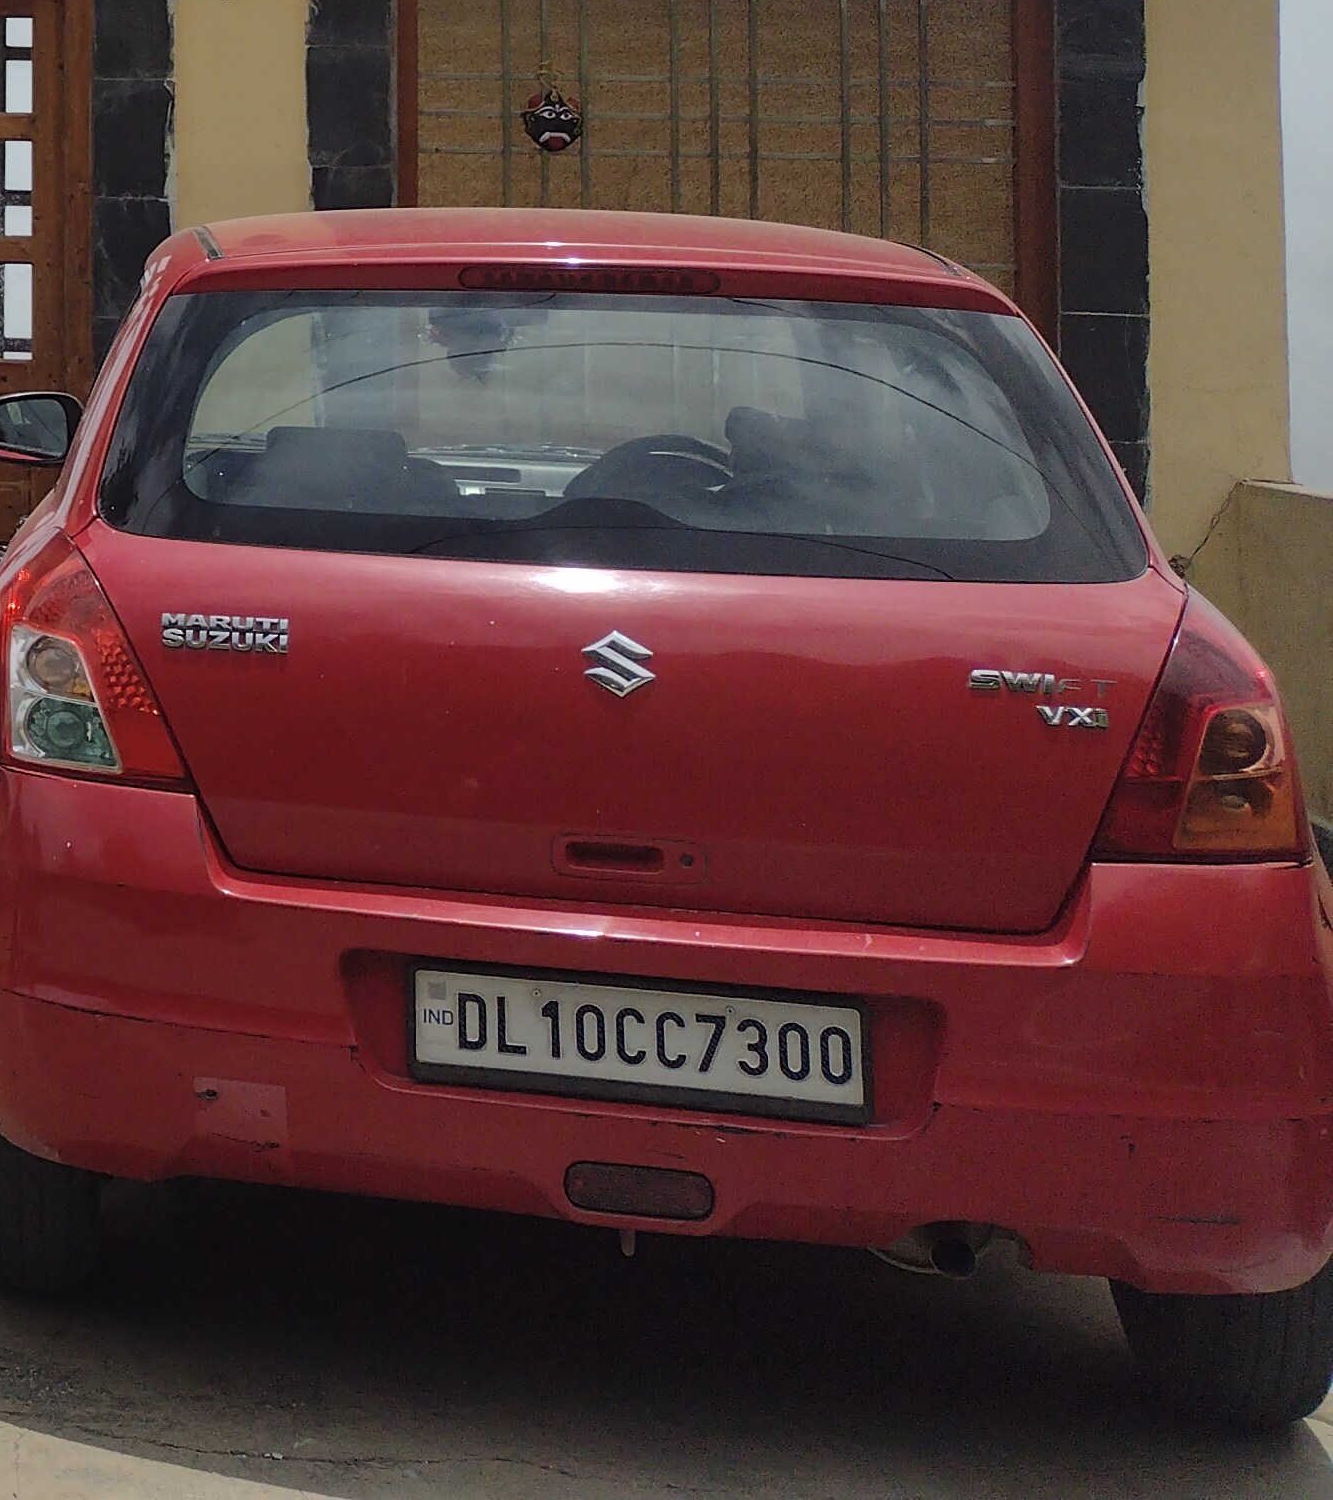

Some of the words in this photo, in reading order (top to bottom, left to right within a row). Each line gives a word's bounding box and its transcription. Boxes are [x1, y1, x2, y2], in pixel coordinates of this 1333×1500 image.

[161, 612, 289, 633] MARUTI
[162, 628, 289, 654] SUZUKI
[968, 669, 1118, 698] SWIFT
[423, 1008, 454, 1026] IND
[457, 992, 853, 1086] DL10CC7300
